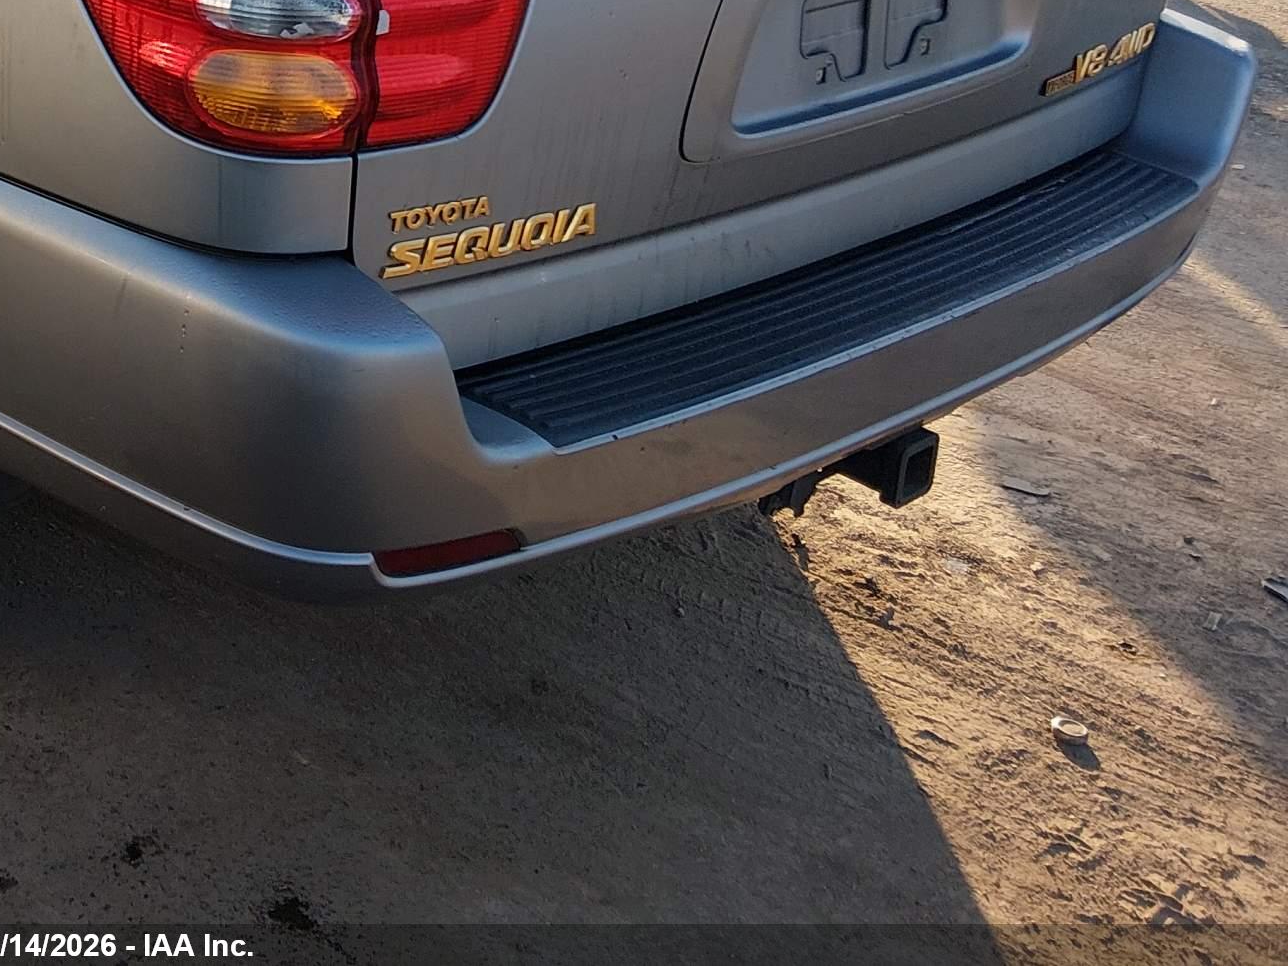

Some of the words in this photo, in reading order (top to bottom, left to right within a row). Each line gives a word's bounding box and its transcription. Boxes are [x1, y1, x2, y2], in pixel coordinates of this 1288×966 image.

[1074, 44, 1108, 83] V8
[389, 196, 491, 234] TOYOTA
[378, 202, 597, 279] SEQUOIA
